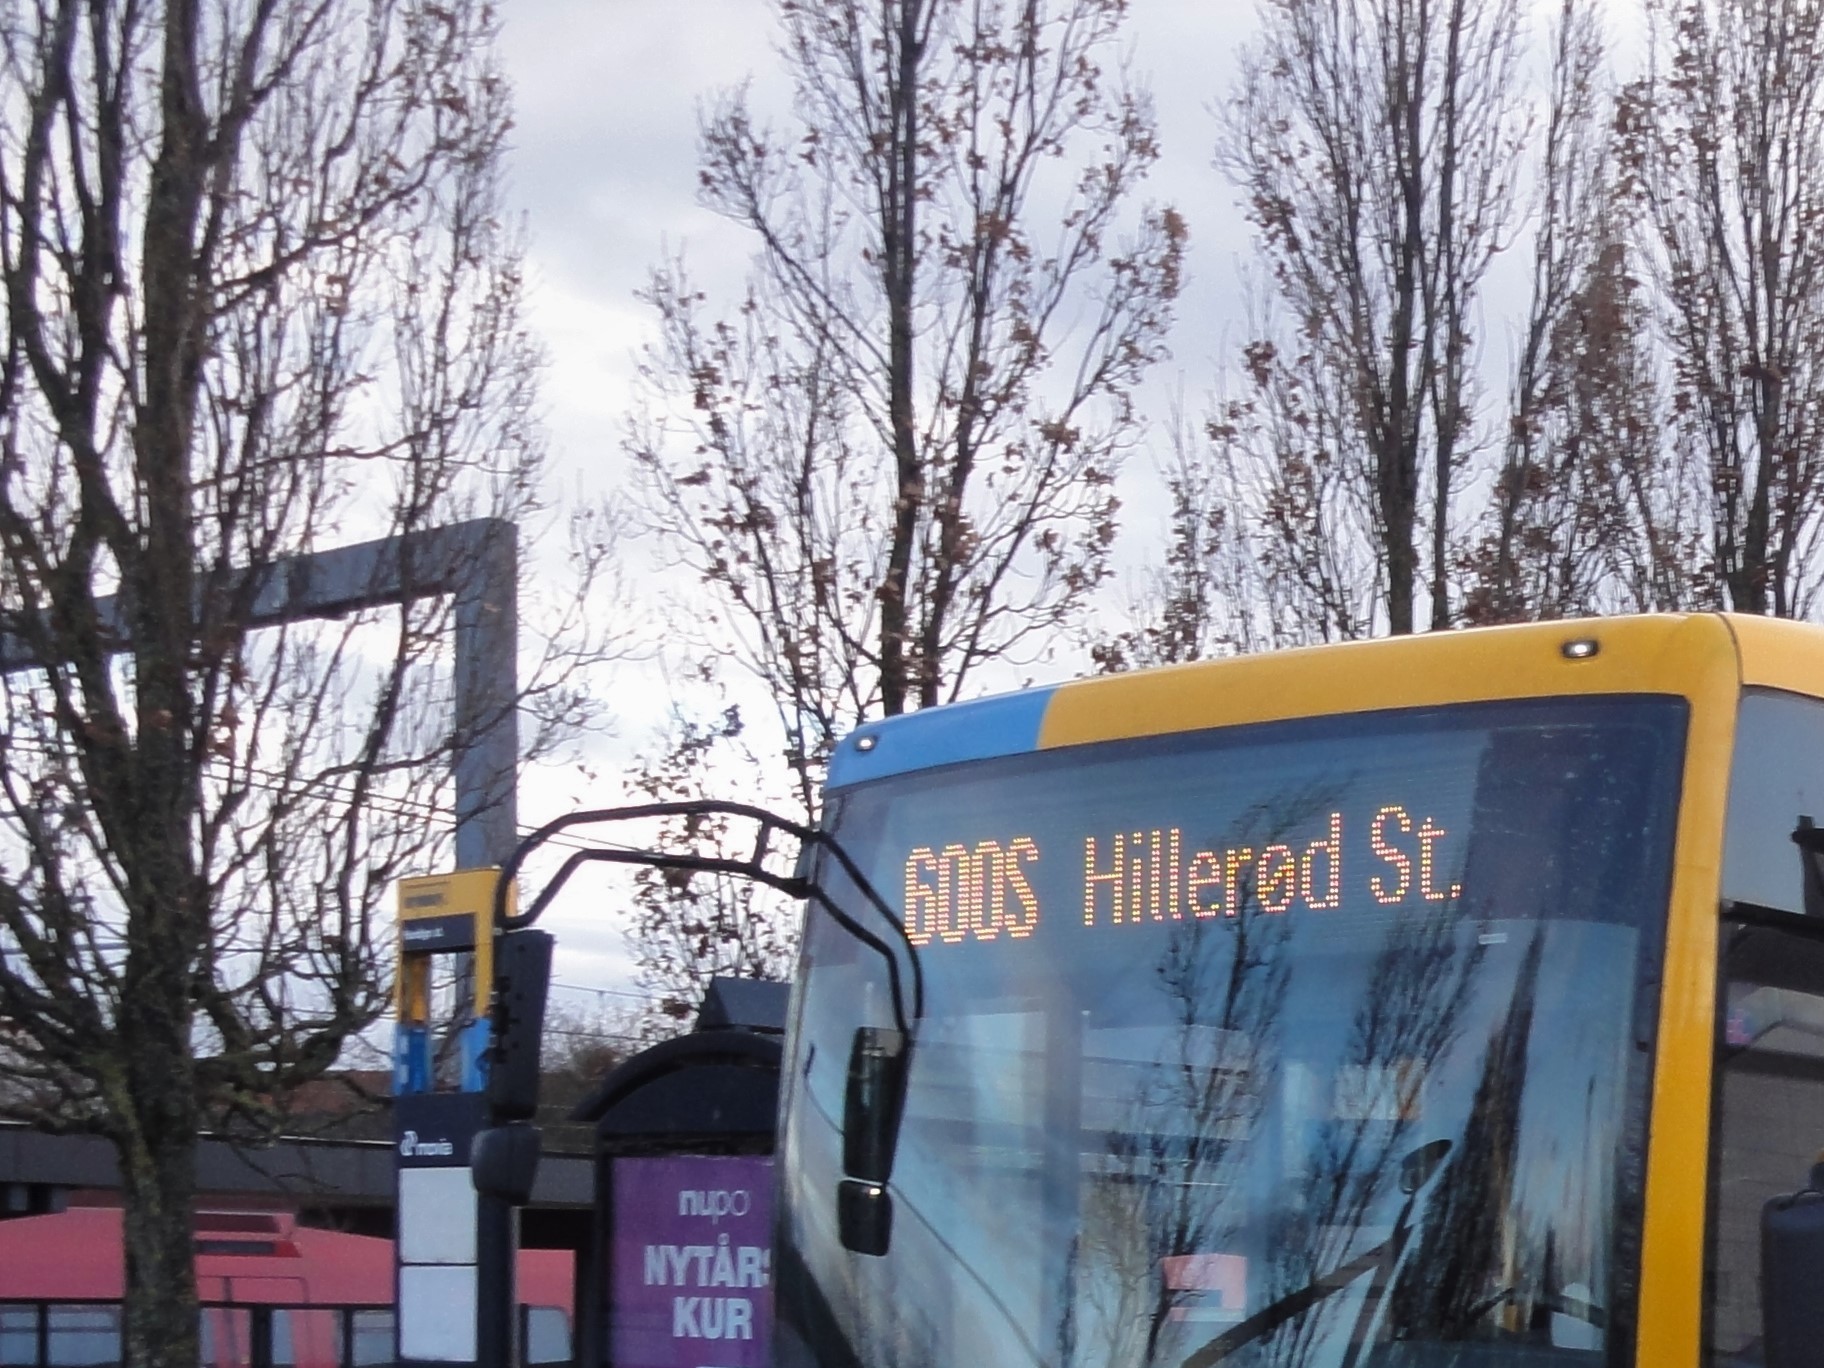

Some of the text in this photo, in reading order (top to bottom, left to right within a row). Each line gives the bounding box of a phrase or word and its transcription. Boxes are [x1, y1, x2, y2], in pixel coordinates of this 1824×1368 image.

[904, 805, 1462, 947] 600S Hillerød St.
[678, 1189, 751, 1225] nupo
[672, 1296, 753, 1340] KUR
